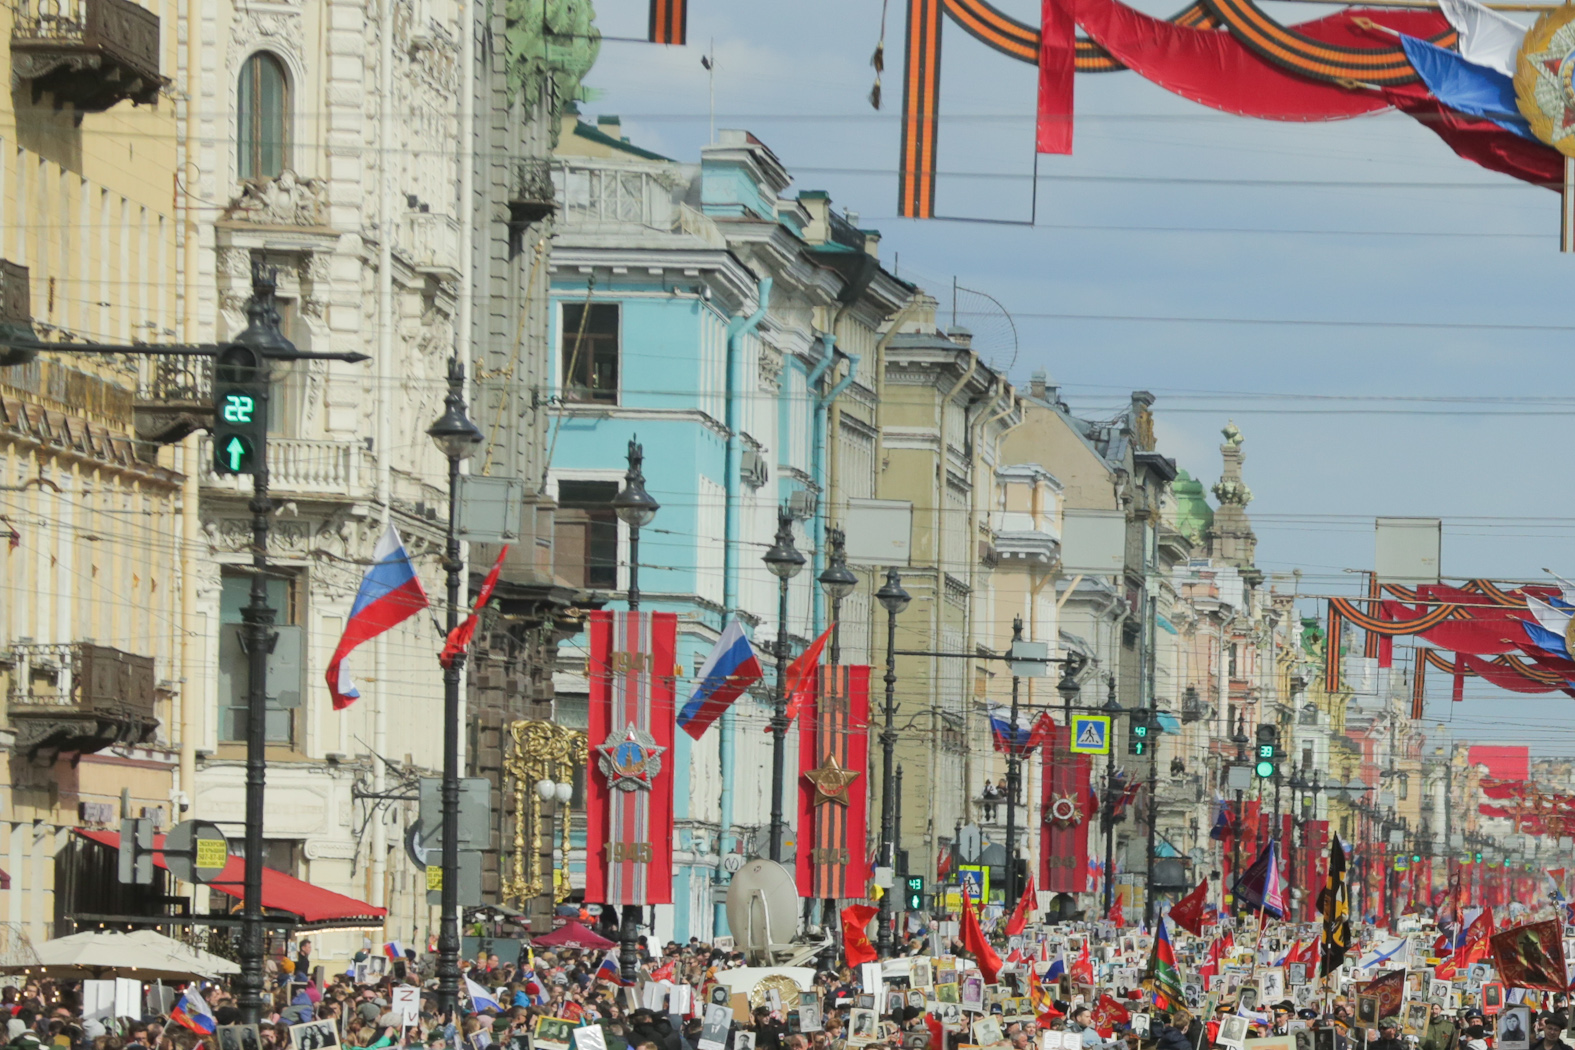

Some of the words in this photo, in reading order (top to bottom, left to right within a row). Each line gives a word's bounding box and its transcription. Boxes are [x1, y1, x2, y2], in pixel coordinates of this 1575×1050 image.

[224, 395, 254, 422] 22
[610, 651, 656, 673] 1941
[603, 841, 653, 863] 1945
[812, 848, 850, 865] 1945
[909, 878, 921, 891] 43
[400, 990, 414, 1001] Z
